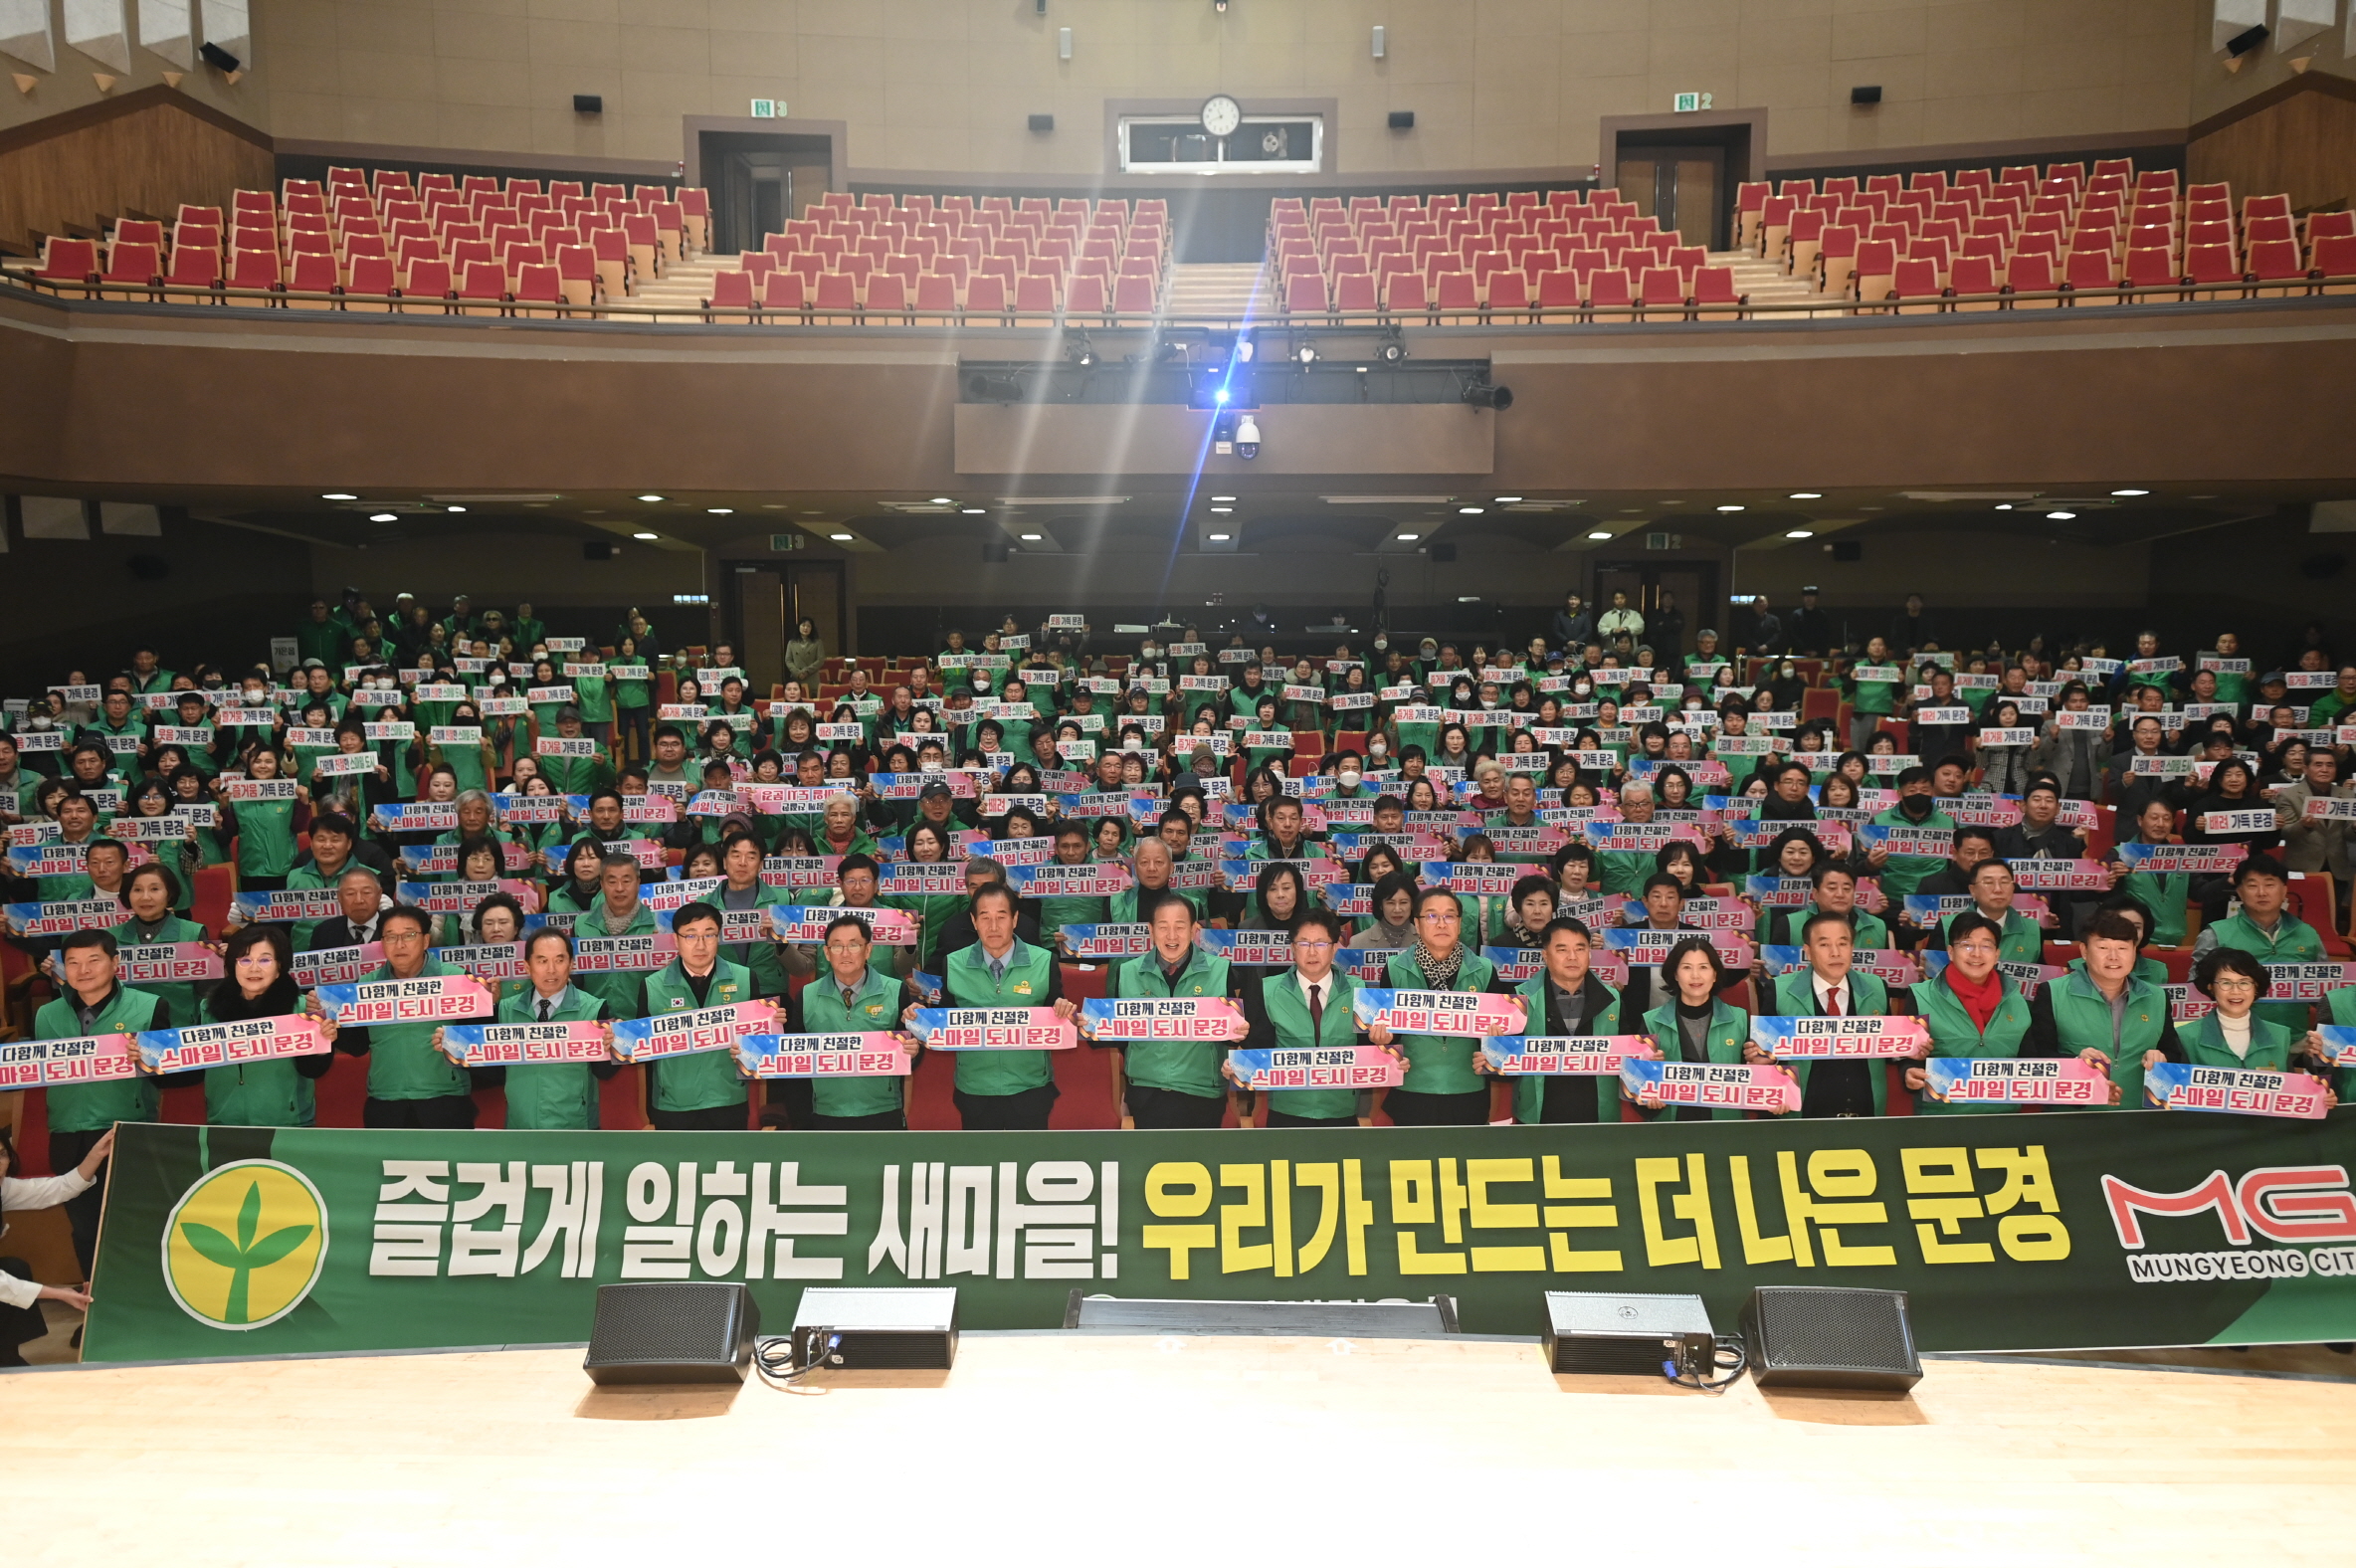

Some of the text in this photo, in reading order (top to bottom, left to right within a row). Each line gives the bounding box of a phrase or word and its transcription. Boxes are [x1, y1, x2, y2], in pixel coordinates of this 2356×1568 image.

[777, 101, 787, 116] 3
[1701, 93, 1711, 108] 2
[1033, 673, 1057, 683] 가득 문경
[223, 710, 273, 722] 즐거움 가득 문경
[1622, 709, 1661, 720] 웃음 가득 문경
[1921, 710, 1966, 721] 배려 가득 문경
[2060, 714, 2106, 727] 배려 가득 문경
[819, 725, 860, 736] 배려 가득 문경
[1982, 730, 2032, 742] 즐거움 가득 문경
[540, 741, 592, 754] 즐거움 가득 문경
[1248, 734, 1288, 746] 웃음 가득 문경
[233, 783, 294, 798] 즐거움 가득 문경
[117, 820, 184, 838] 웃음 가득 문경
[2210, 813, 2272, 830] 배려 가득 문경
[1644, 826, 1670, 835] 친절한
[1598, 838, 1660, 850] 스마일 도시
[2155, 848, 2184, 857] 다함께
[2135, 858, 2239, 871] 스마일 도시 문경
[1037, 868, 1096, 878] 다함께 친절한
[432, 883, 497, 895] 다함께 친절한
[1021, 880, 1120, 894] 스마일 도시 문경
[416, 898, 459, 911] 스마일
[358, 980, 442, 1000] 다함께 친절한
[339, 995, 476, 1023] 스마일 도시 문경
[1116, 1001, 1196, 1016] 다함께 친절한
[1396, 993, 1477, 1011] 다함께 친절한
[653, 1015, 693, 1034] 다함께
[696, 1008, 735, 1027] 친절한
[949, 1011, 1030, 1026] 다함께 친절한
[1376, 1010, 1509, 1033] 스마일 도시 문경
[181, 1021, 273, 1044] 다함께 친절한
[486, 1026, 567, 1042] 다함께 친절한
[1097, 1019, 1228, 1037] 스마일 도시 문경
[1798, 1020, 1881, 1034] 다함께 친절한
[635, 1033, 687, 1057] 스마일
[693, 1026, 729, 1048] 도시
[780, 1036, 862, 1052] 다함께 친절한
[929, 1028, 1061, 1046] 스마일 도시 문경
[2, 1040, 96, 1063] 다함께 친절한
[161, 1032, 313, 1069] 스마일 도시 문경
[468, 1041, 603, 1062] 스마일 도시 문경
[1526, 1040, 1609, 1053] 다함께 친절한
[1775, 1036, 1913, 1056] 스마일 도시 문경
[759, 1053, 893, 1074] 스마일 도시 문경
[1274, 1051, 1354, 1067] 다함께 친절한
[1504, 1056, 1557, 1072] 스마일
[1564, 1056, 1599, 1072] 도시
[47, 1056, 134, 1079] 도시 문경
[1665, 1066, 1750, 1083] 다함께 친절한
[1973, 1063, 2059, 1077] 다함께 친절한
[1254, 1067, 1387, 1086] 스마일 도시 문경
[2193, 1070, 2282, 1090] 다함께 친절한
[1641, 1082, 1784, 1106] 스마일 도시 문경
[1949, 1080, 2092, 1099] 스마일 도시 문경
[2170, 1086, 2314, 1113] 스마일 도시 문경
[370, 1146, 2069, 1279] 즐겁게 일하는 새마을! 우리가 만드는 더 나은 문경
[2101, 1166, 2356, 1249] MG
[2132, 1254, 2304, 1278] MUNGYEONG
